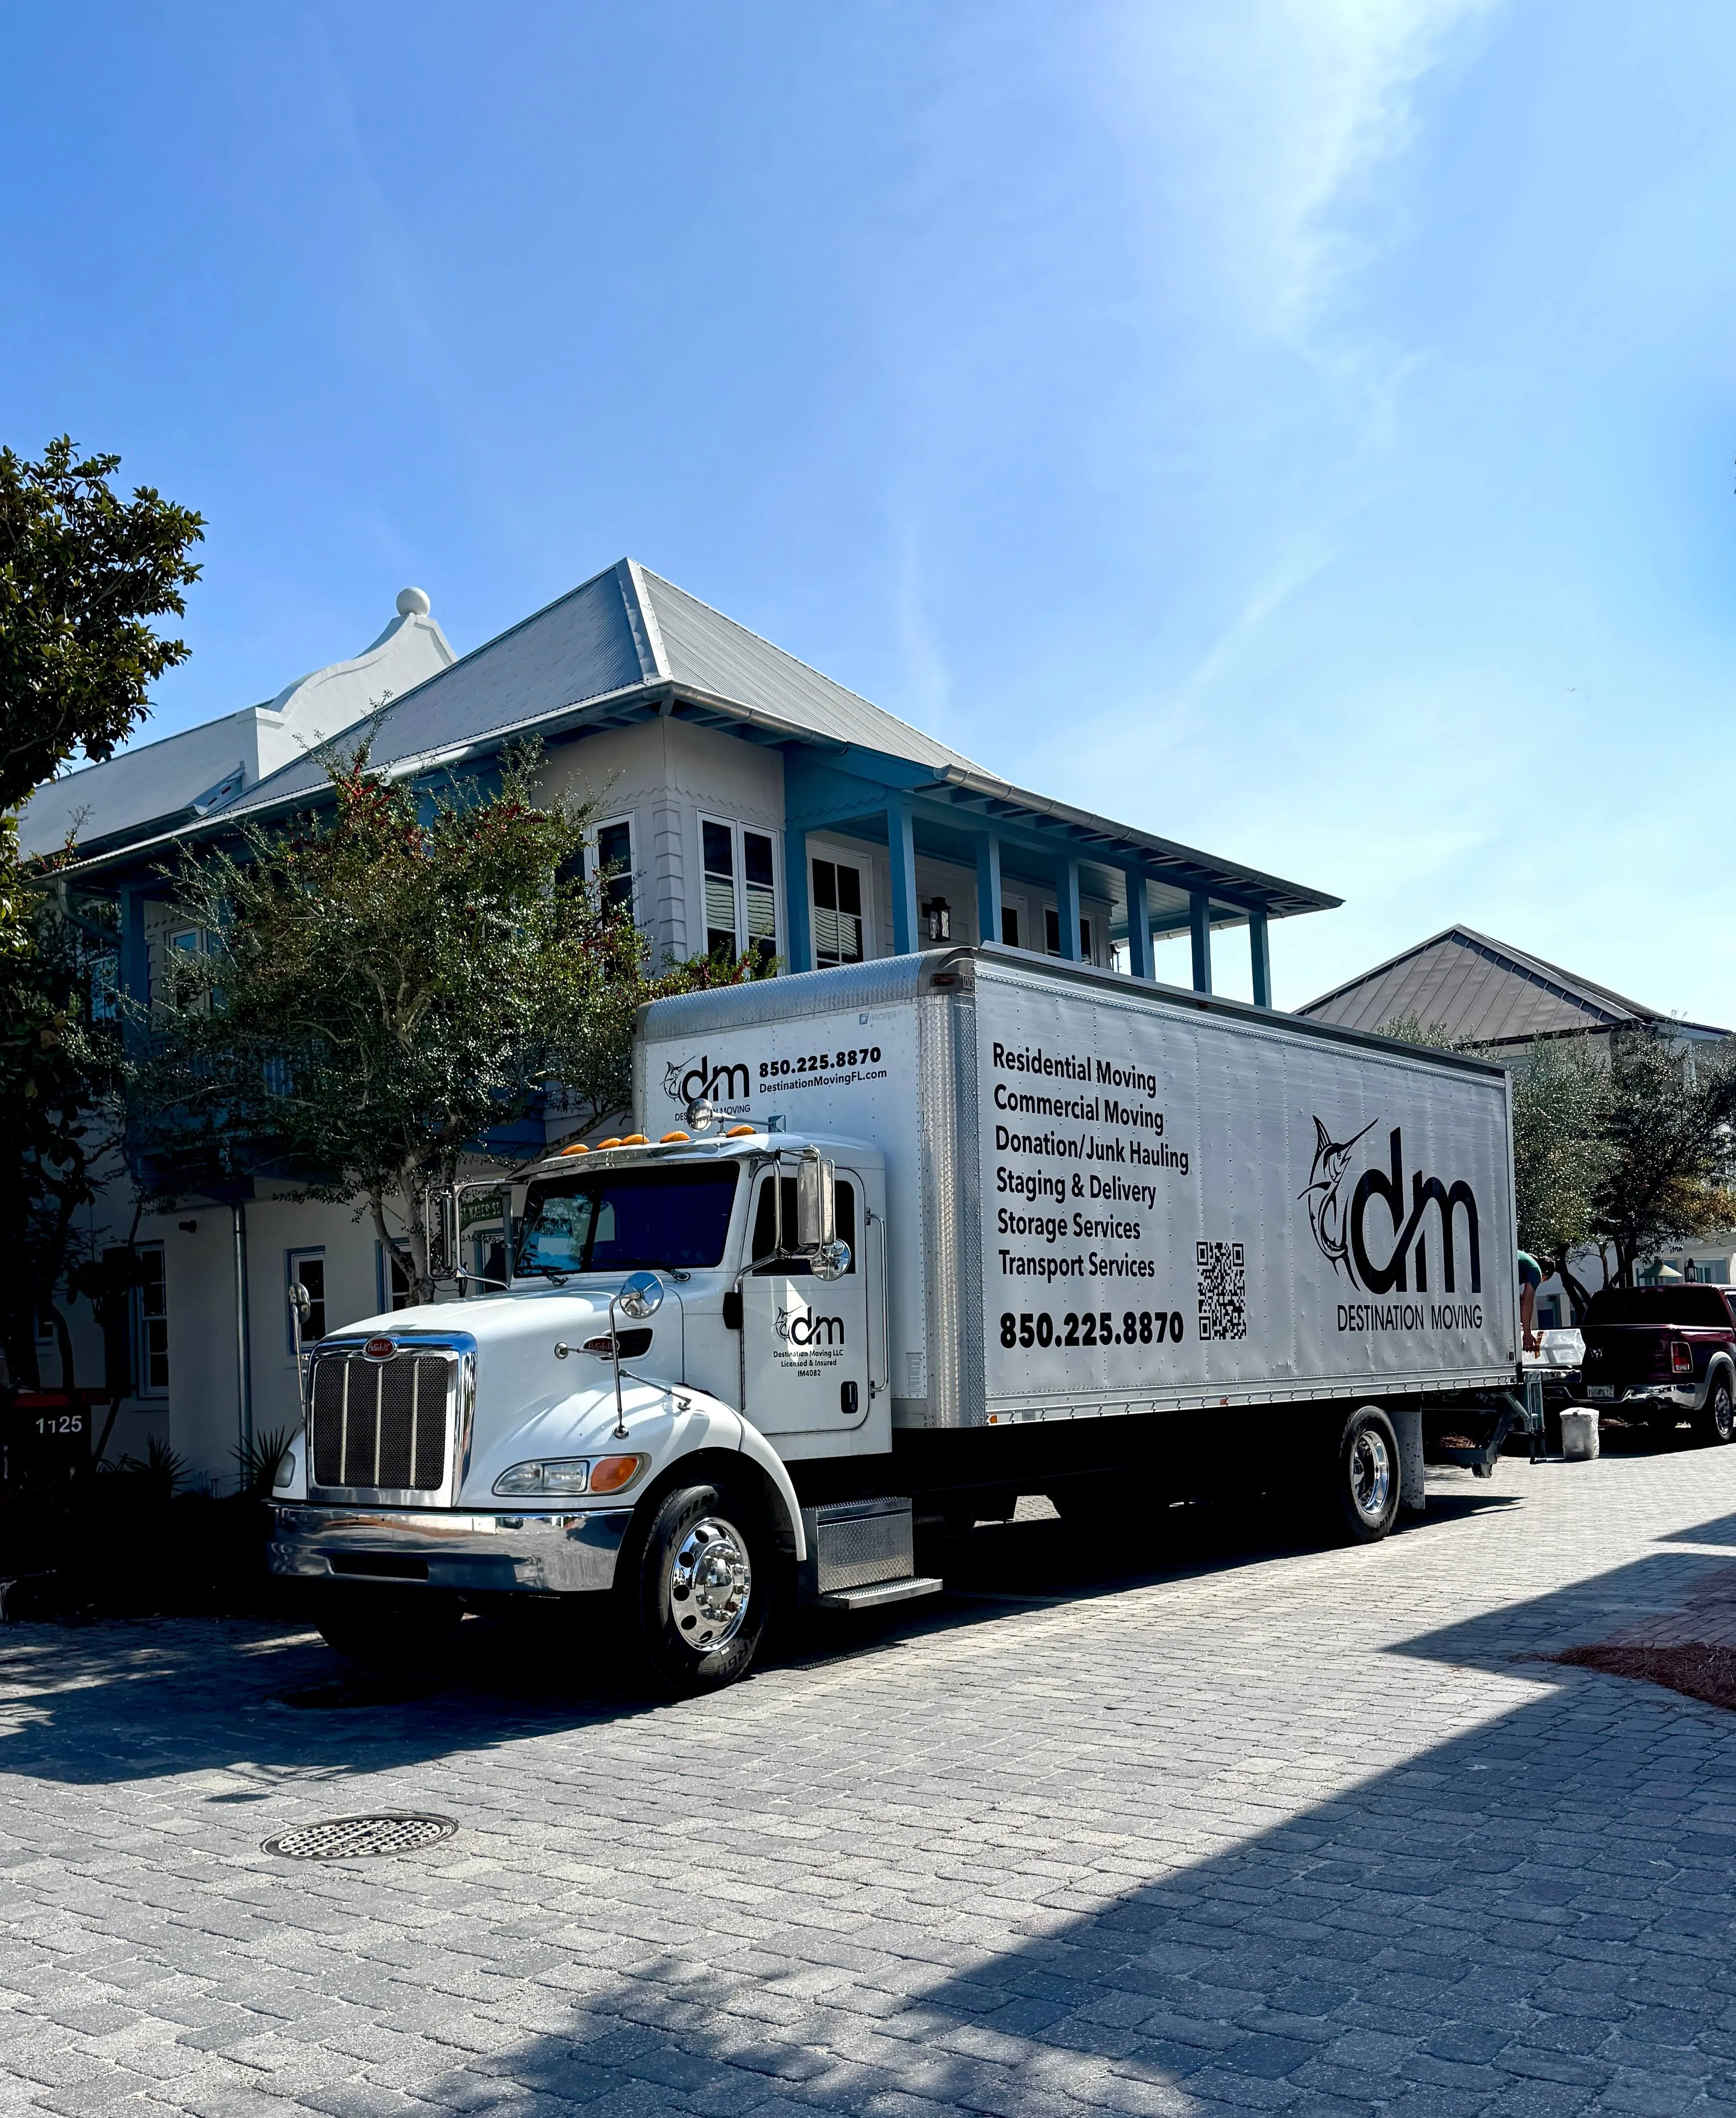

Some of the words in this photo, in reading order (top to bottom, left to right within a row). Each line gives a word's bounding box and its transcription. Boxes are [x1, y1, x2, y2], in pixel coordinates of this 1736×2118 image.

[682, 1055, 750, 1105] dm
[759, 1047, 881, 1078] 850.225.8870
[993, 1042, 1091, 1082] Residential
[1097, 1059, 1156, 1097] Moving
[759, 1069, 887, 1093] DestinationMovingFL.com
[994, 1083, 1099, 1121] Commercial
[1104, 1099, 1164, 1136] Moving
[995, 1125, 1125, 1164] Donation/Junk
[1130, 1140, 1189, 1175] Hauling
[996, 1167, 1065, 1204] Staging
[1071, 1173, 1085, 1198] &
[1090, 1175, 1156, 1210] Delivery
[997, 1208, 1068, 1243] Storage
[1072, 1212, 1141, 1240] Services
[1350, 1126, 1481, 1295] dm
[998, 1249, 1085, 1283] Transport
[1088, 1251, 1155, 1277] Services
[791, 1306, 844, 1346] dm
[1000, 1312, 1184, 1348] 850.225.8870
[1338, 1305, 1424, 1331] DESTINATION
[1431, 1305, 1483, 1330] MOVING
[809, 1349, 832, 1358] Moving
[35, 1415, 82, 1433] 1125
